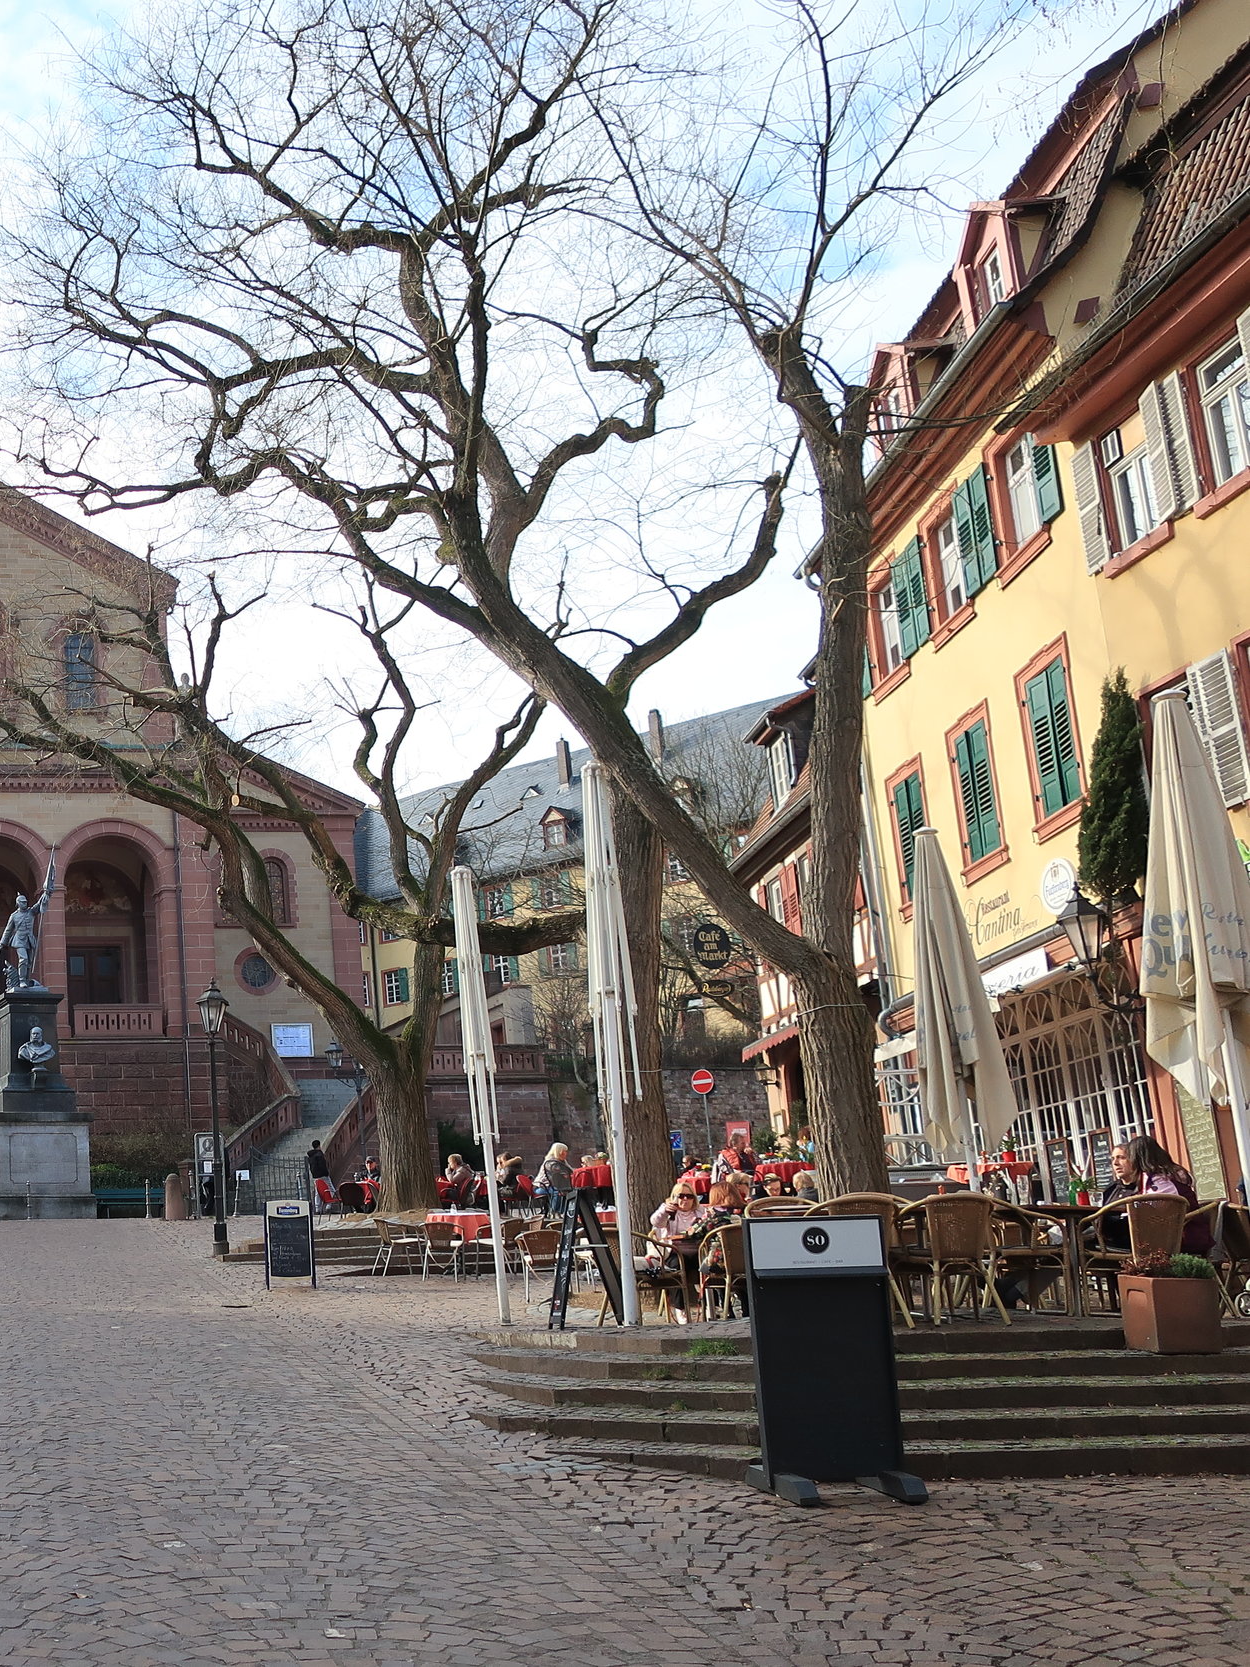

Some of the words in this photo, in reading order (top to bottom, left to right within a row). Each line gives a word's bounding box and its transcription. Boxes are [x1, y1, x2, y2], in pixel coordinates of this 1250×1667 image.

[981, 890, 1010, 916] Restaurant
[975, 897, 1022, 946] Cantina
[698, 930, 721, 942] Café
[698, 951, 728, 961] Markt
[806, 1234, 826, 1246] SO
